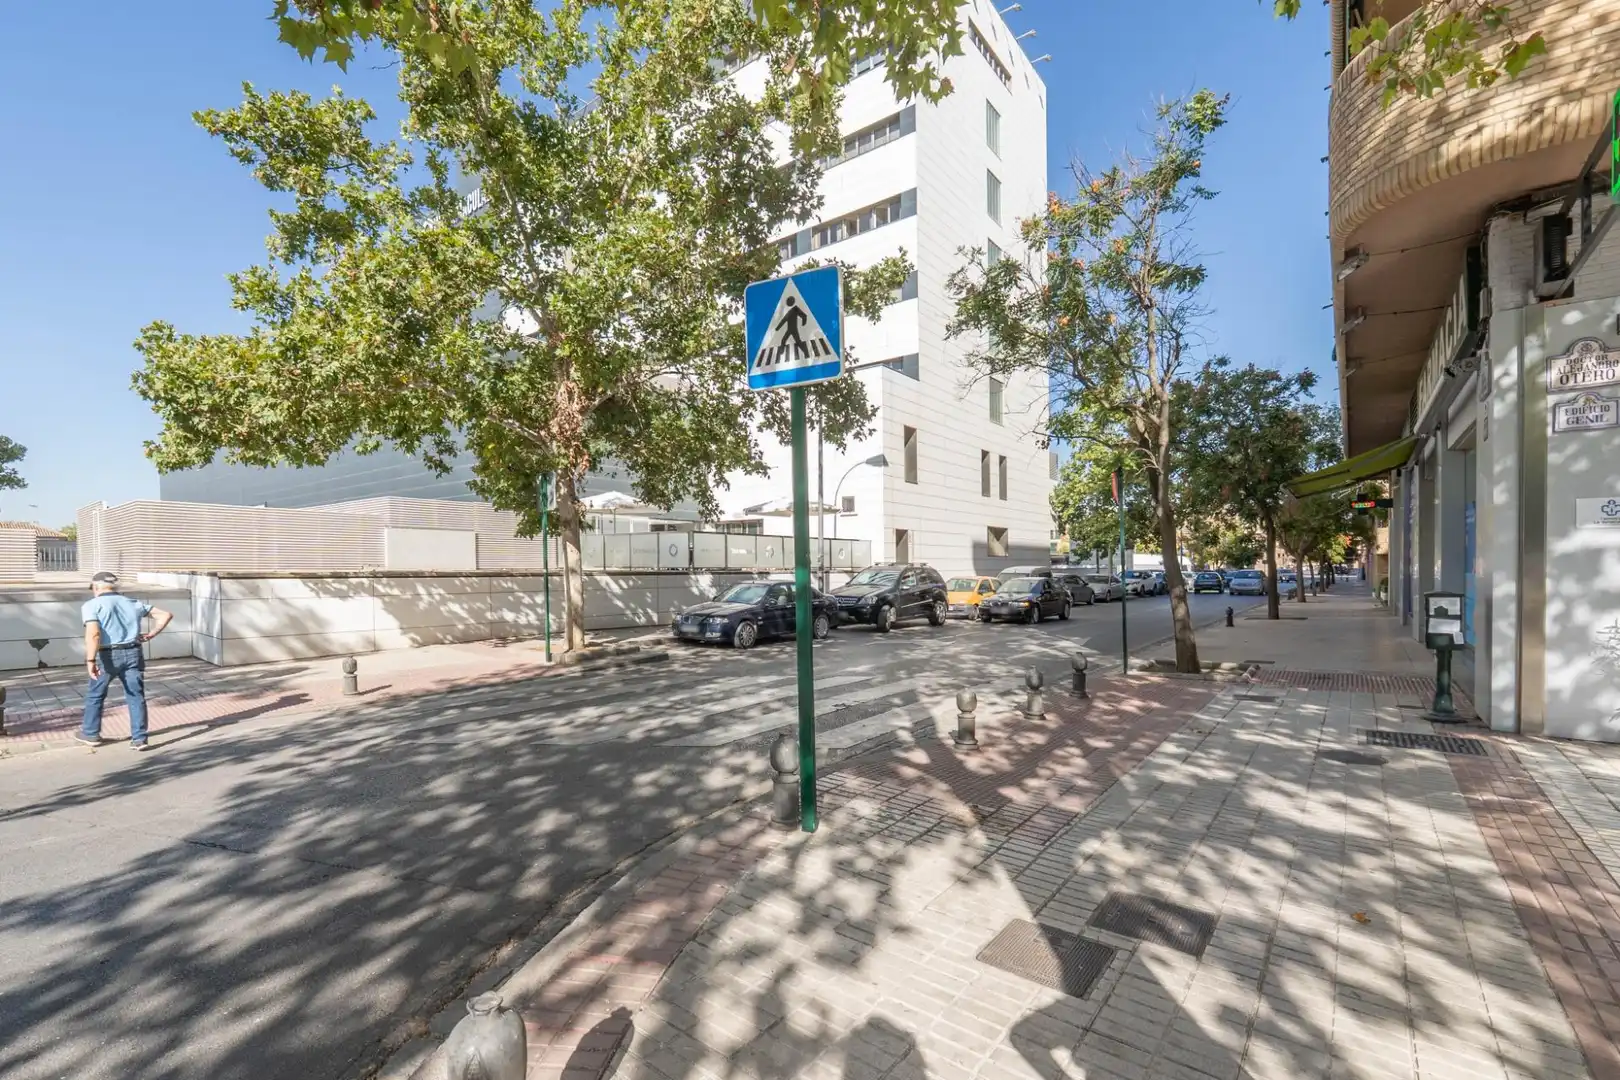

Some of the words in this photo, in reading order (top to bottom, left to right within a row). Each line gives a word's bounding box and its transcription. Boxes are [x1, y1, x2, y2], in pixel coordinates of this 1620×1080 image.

[1566, 354, 1609, 365] DOCTOR
[1556, 359, 1619, 375] ALEJANDRO
[1560, 368, 1616, 385] OTERO
[1564, 404, 1610, 416] EDIFICIO
[1566, 414, 1608, 425] GENIL
